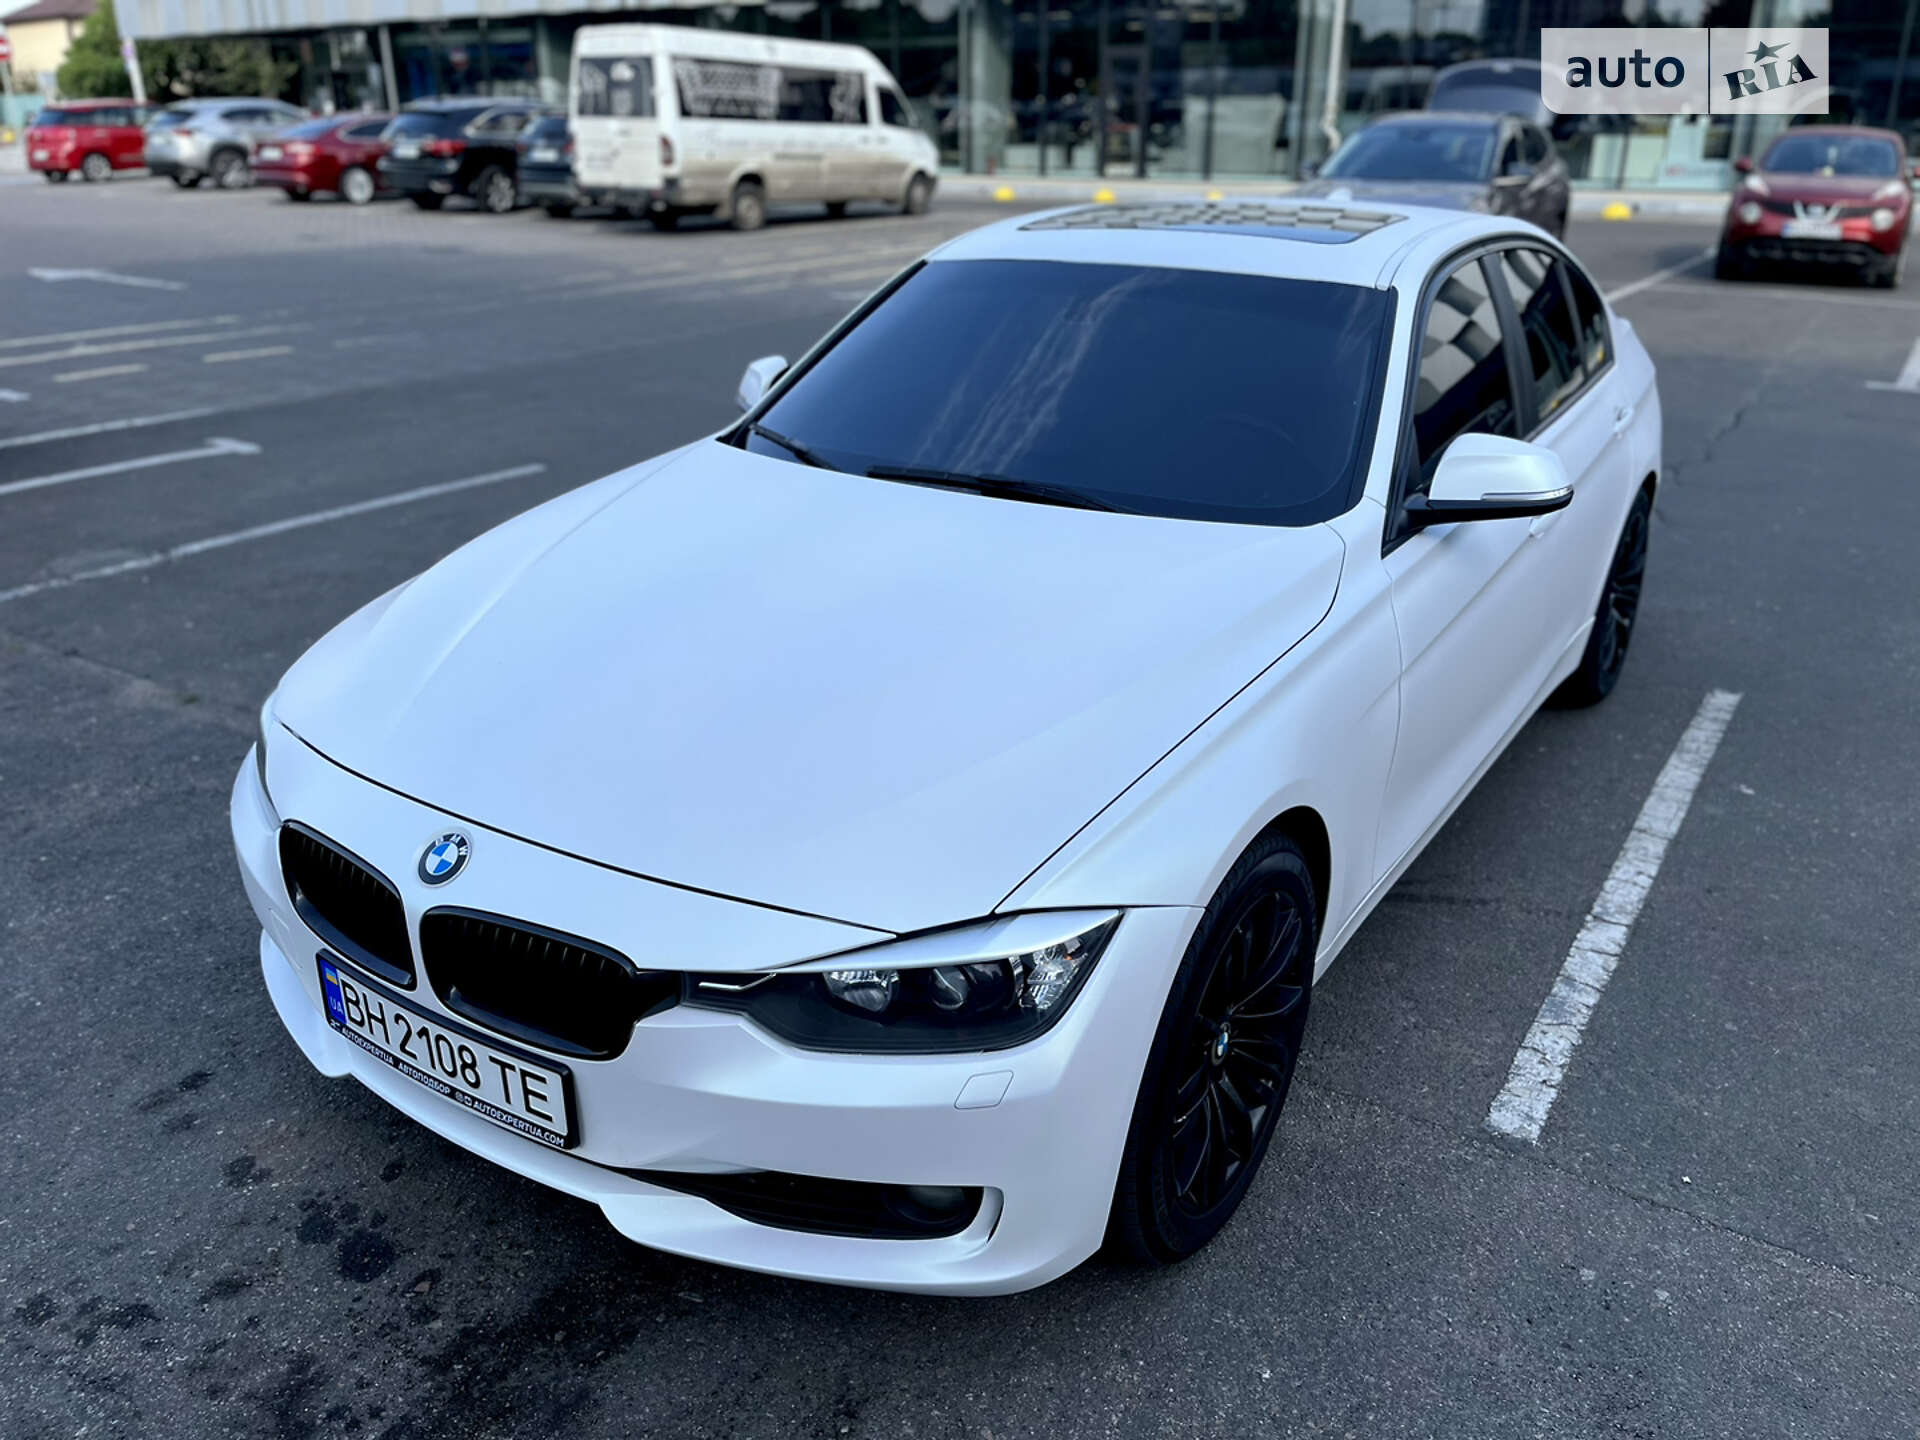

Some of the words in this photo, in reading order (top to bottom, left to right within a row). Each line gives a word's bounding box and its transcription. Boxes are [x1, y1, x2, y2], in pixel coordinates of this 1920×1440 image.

[329, 996, 345, 1016] UA
[340, 979, 391, 1045] BH
[393, 1012, 481, 1090] 2108
[488, 1055, 554, 1123] TE
[473, 1100, 565, 1148] AUTOEXPERTUA.COM
